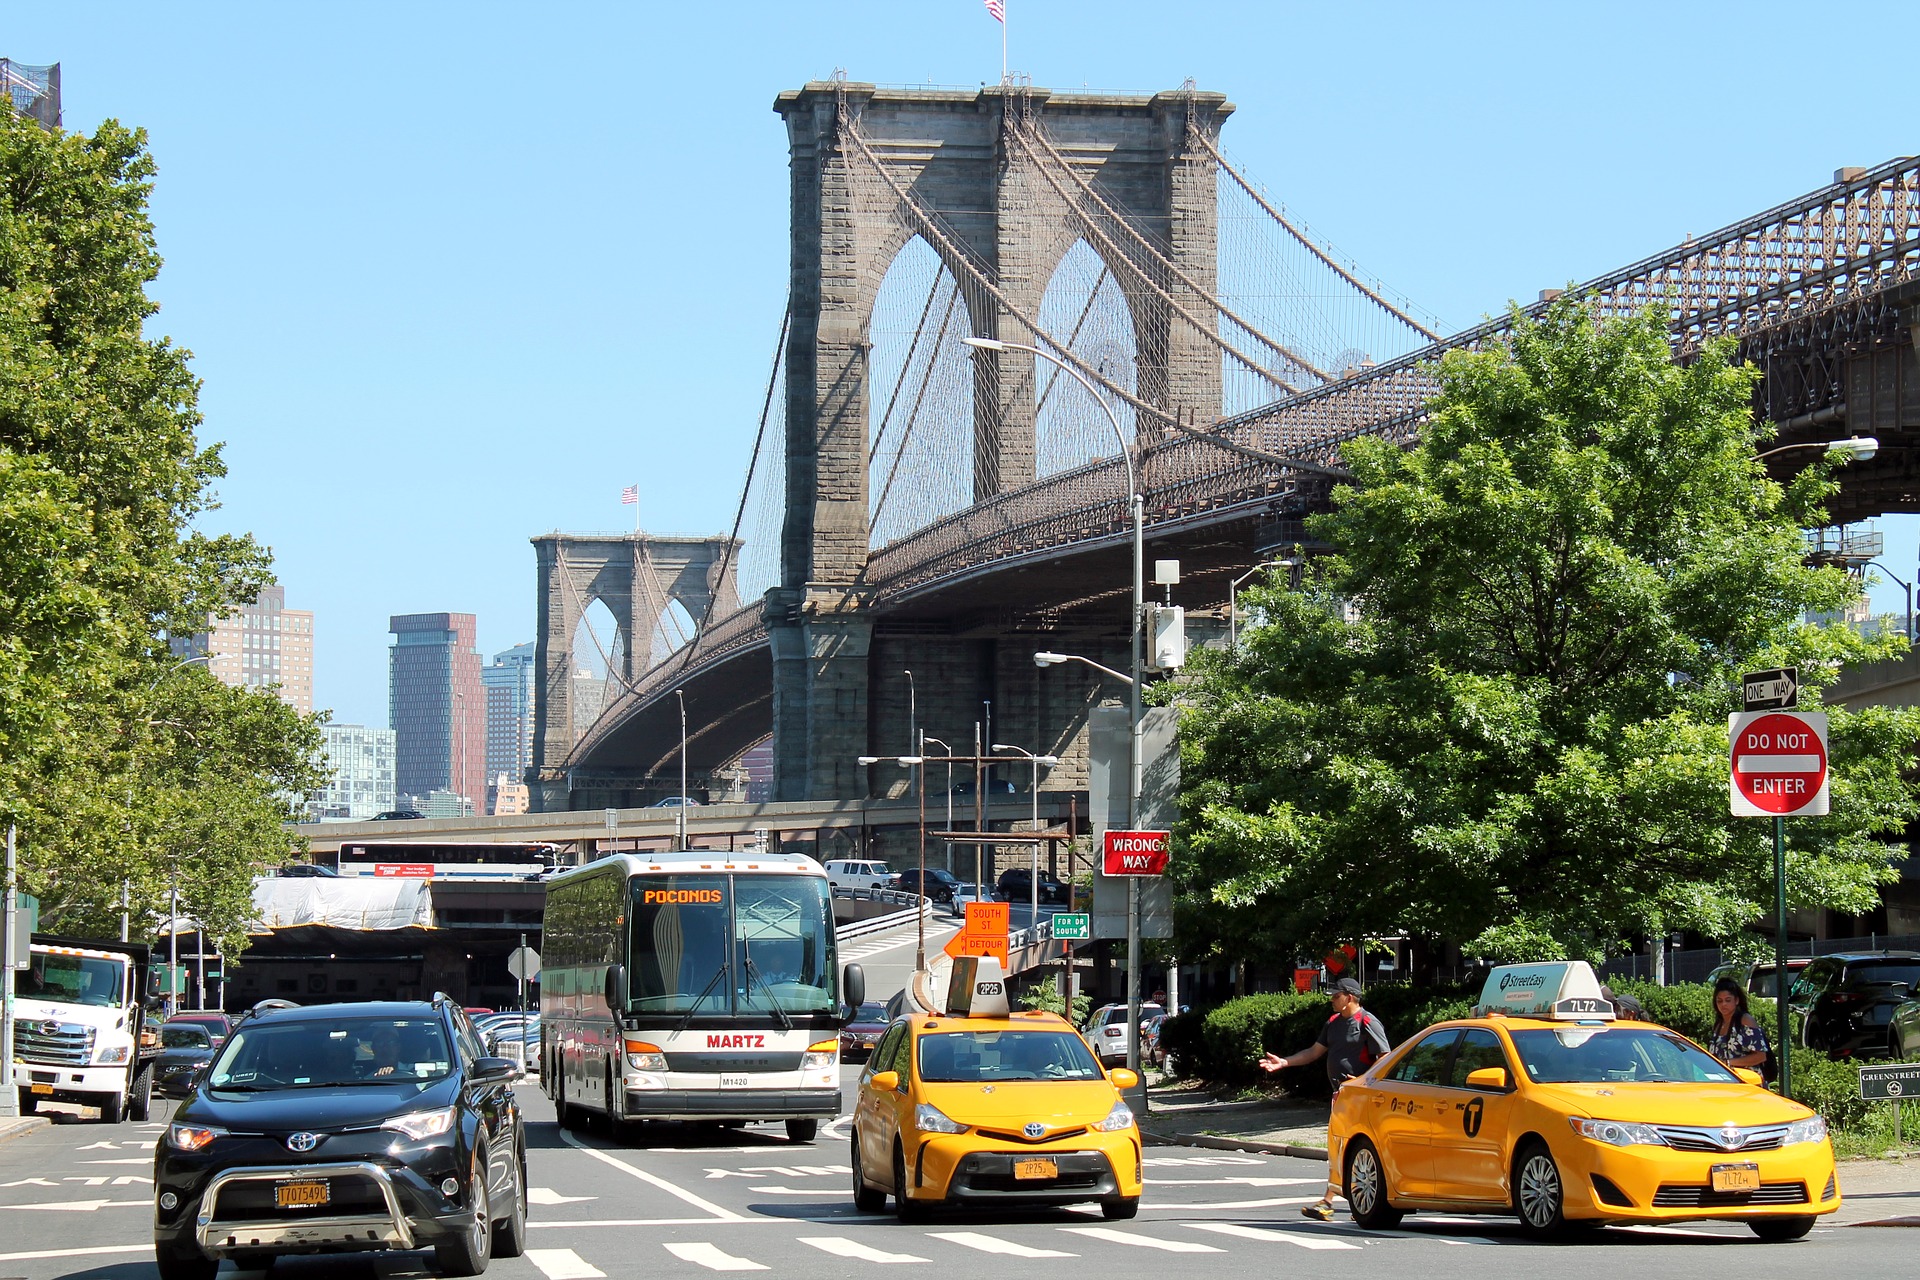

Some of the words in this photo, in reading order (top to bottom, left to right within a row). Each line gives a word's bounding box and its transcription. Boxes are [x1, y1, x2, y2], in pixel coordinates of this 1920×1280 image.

[1747, 684, 1764, 700] ONE
[1773, 680, 1790, 698] WAY
[1748, 734, 1770, 749] DO
[1777, 734, 1808, 749] NOT
[1753, 778, 1806, 794] ENTER
[1113, 838, 1161, 852] WRONG
[1122, 855, 1152, 869] WAY
[644, 889, 722, 904] POCONOS
[973, 909, 1001, 919] SOUTH
[981, 921, 992, 930] ST.
[970, 941, 1003, 949] DETOUR
[1508, 974, 1547, 989] StreetEasy
[980, 984, 998, 995] 2P25
[1570, 1000, 1596, 1012] 7L72
[707, 1035, 765, 1048] MARTZ
[722, 1078, 748, 1086] M1420
[280, 1187, 325, 1202] T707549C
